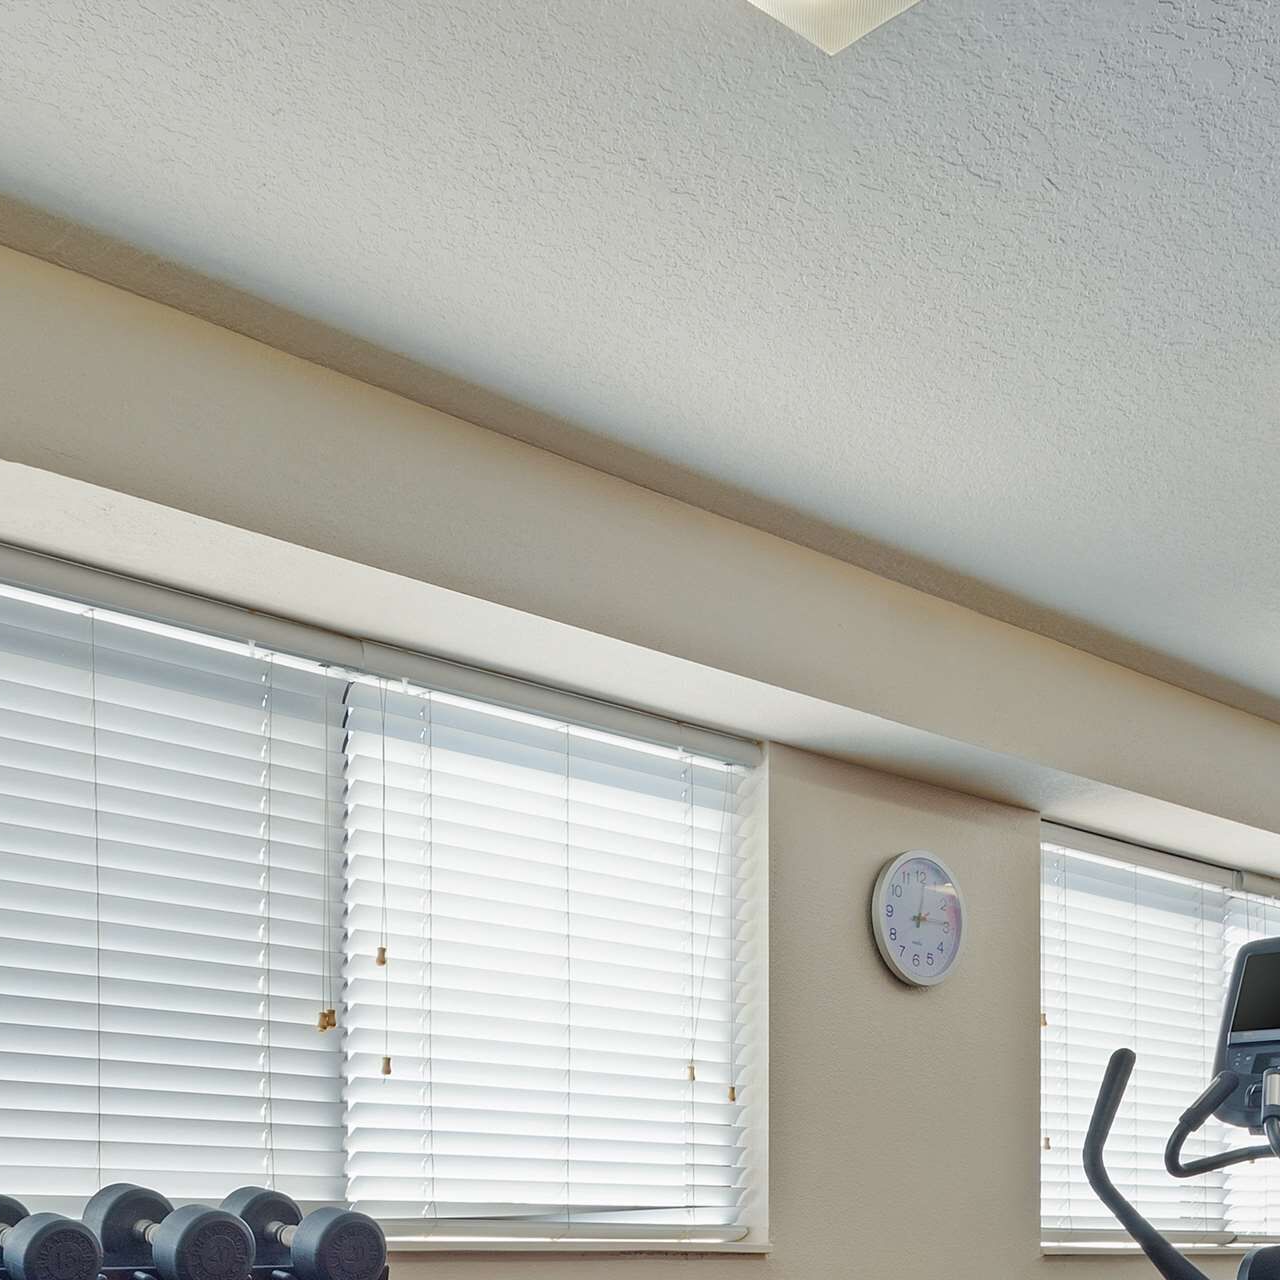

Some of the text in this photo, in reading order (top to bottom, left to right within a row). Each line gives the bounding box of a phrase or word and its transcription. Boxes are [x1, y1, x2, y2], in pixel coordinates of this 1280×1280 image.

[902, 872, 911, 885] 11
[914, 870, 927, 884] 12
[891, 884, 903, 898] 10
[885, 904, 894, 917] 9
[939, 899, 947, 911] 2
[889, 927, 897, 941] 8
[942, 921, 950, 934] 3
[898, 945, 906, 957] 7
[936, 941, 945, 953] 4
[912, 953, 920, 967] 6
[926, 952, 934, 966] 5
[55, 1251, 78, 1270] 15
